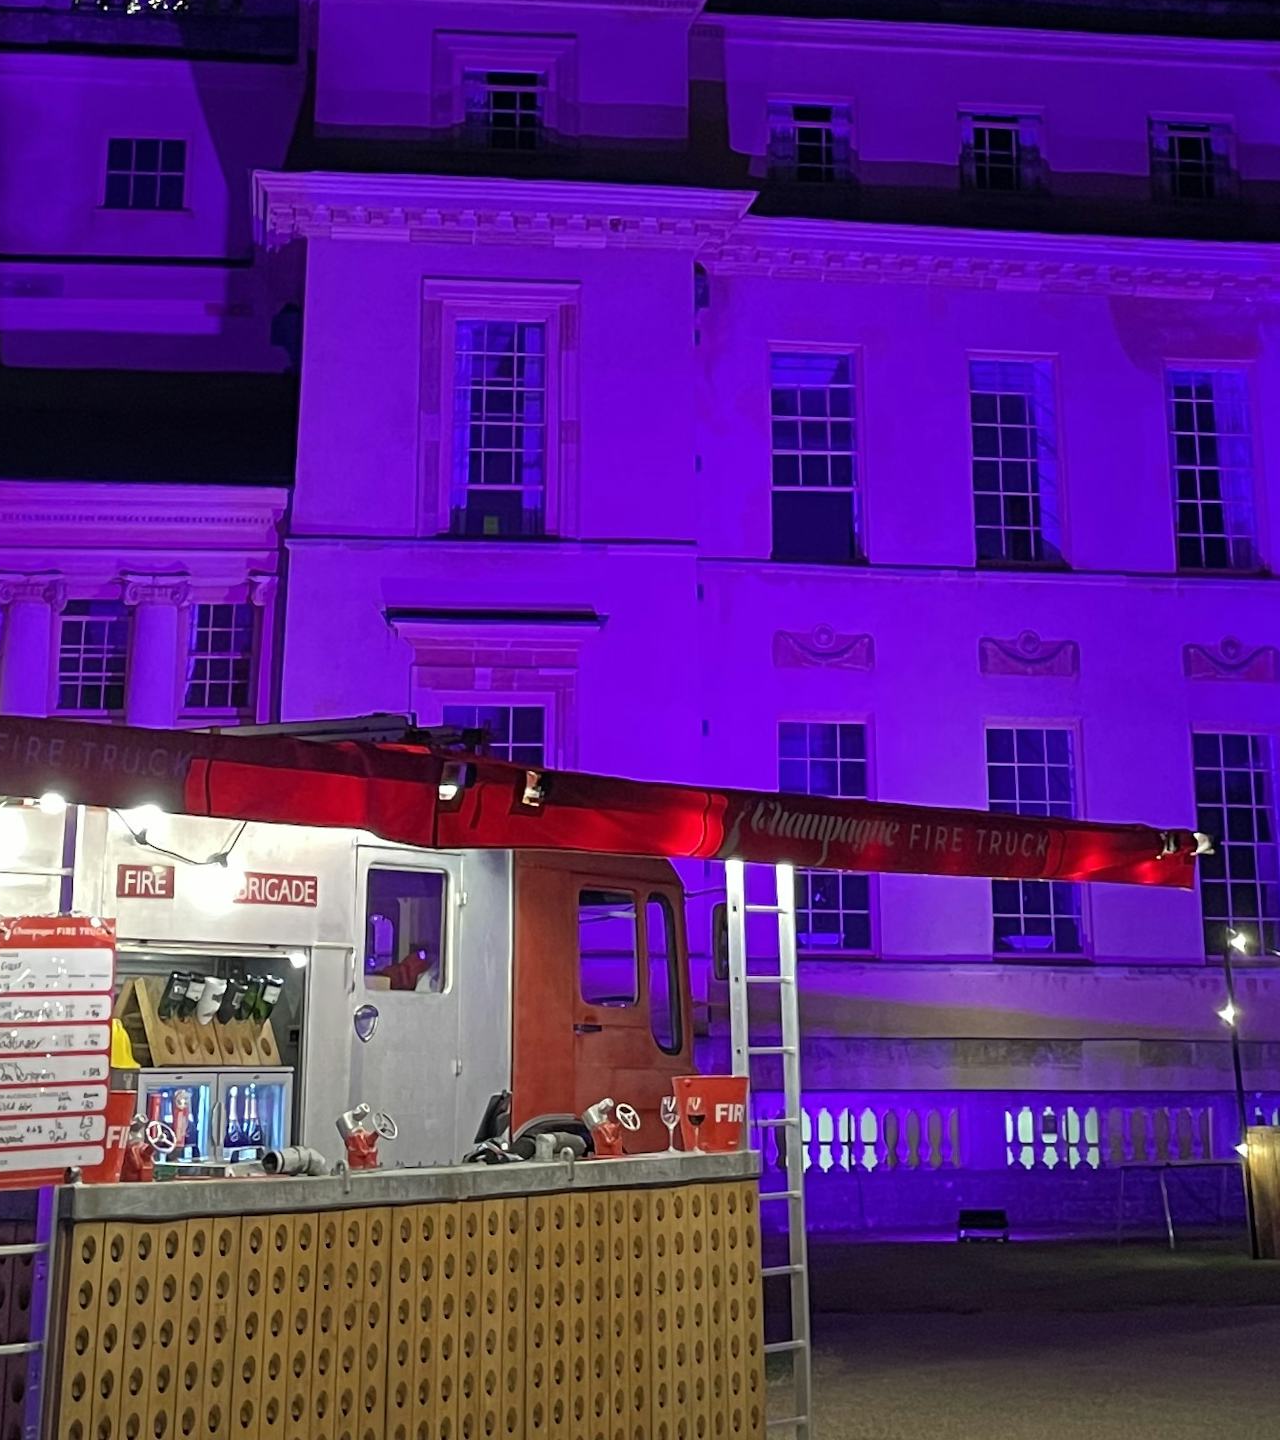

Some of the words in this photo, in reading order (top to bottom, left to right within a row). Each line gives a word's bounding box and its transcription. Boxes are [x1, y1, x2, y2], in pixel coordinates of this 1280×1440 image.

[81, 741, 193, 778] TRUCK
[751, 799, 900, 866] Champagne
[909, 823, 964, 853] FIRE
[976, 828, 1049, 858] TRUCK
[124, 869, 167, 895] FIRE
